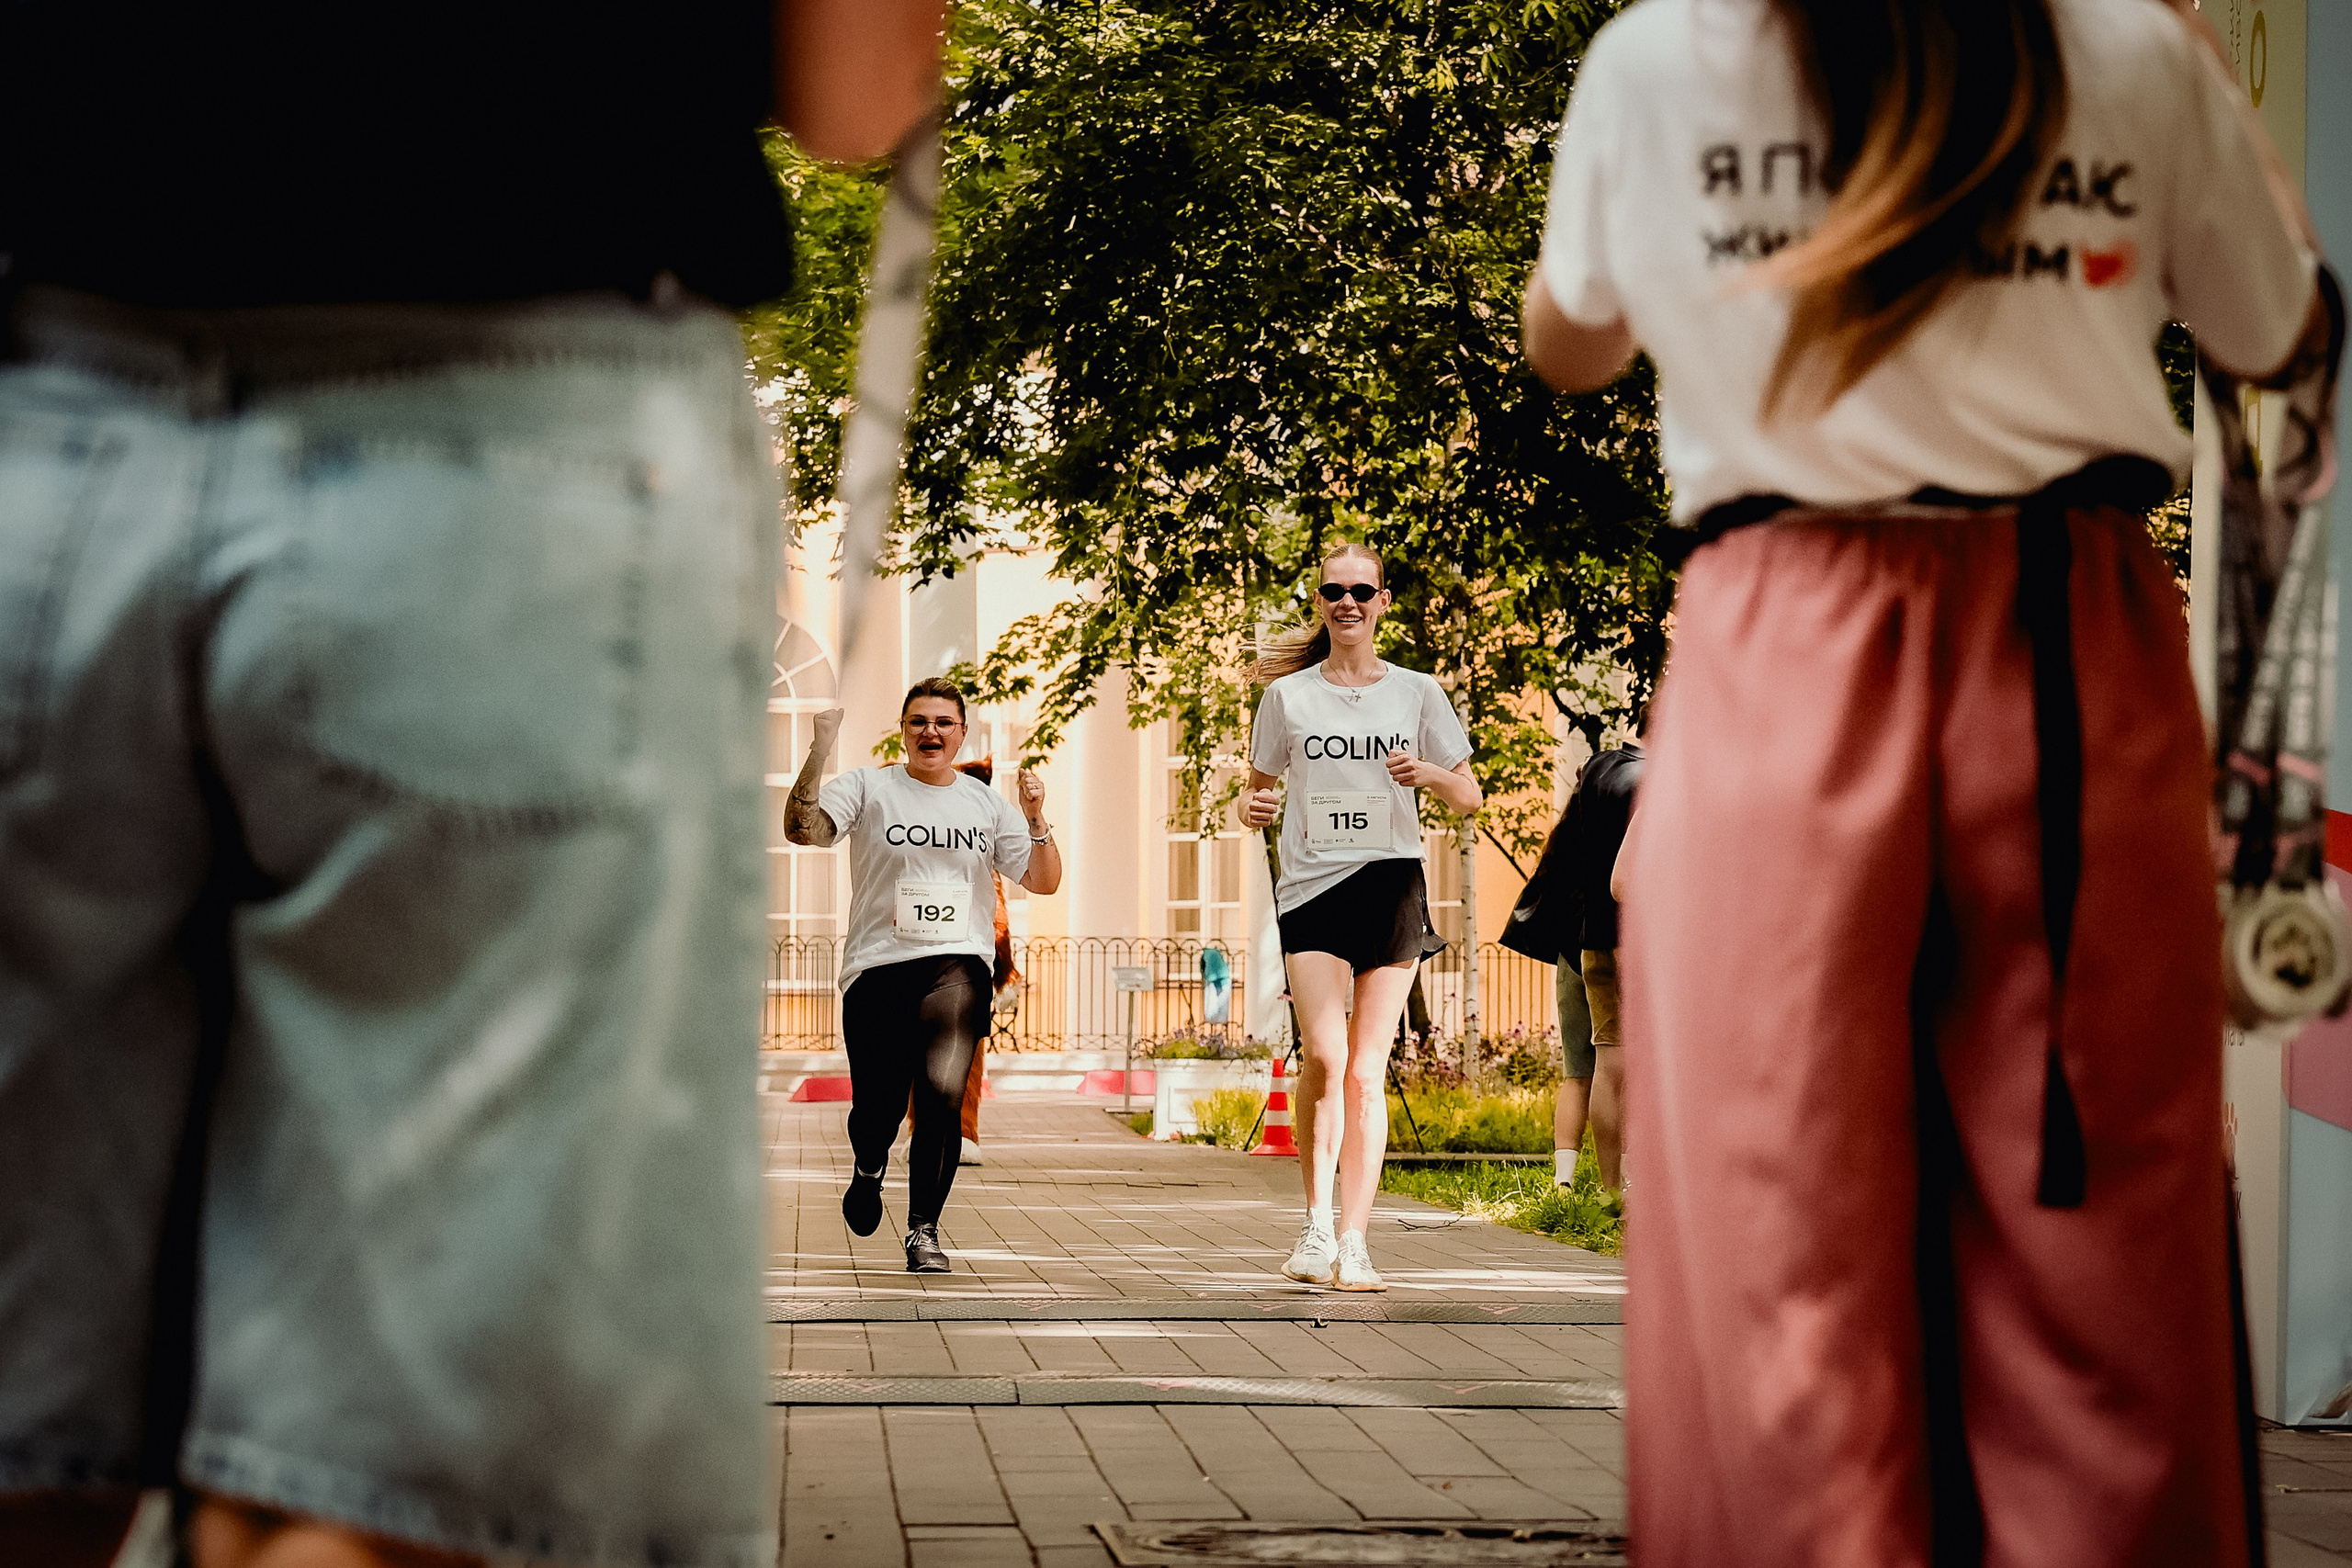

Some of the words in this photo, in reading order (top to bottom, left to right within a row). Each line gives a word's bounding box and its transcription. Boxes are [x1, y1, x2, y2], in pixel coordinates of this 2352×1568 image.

[1702, 142, 1741, 196] Я
[1329, 812, 1368, 829] 115
[913, 905, 956, 922] 192
